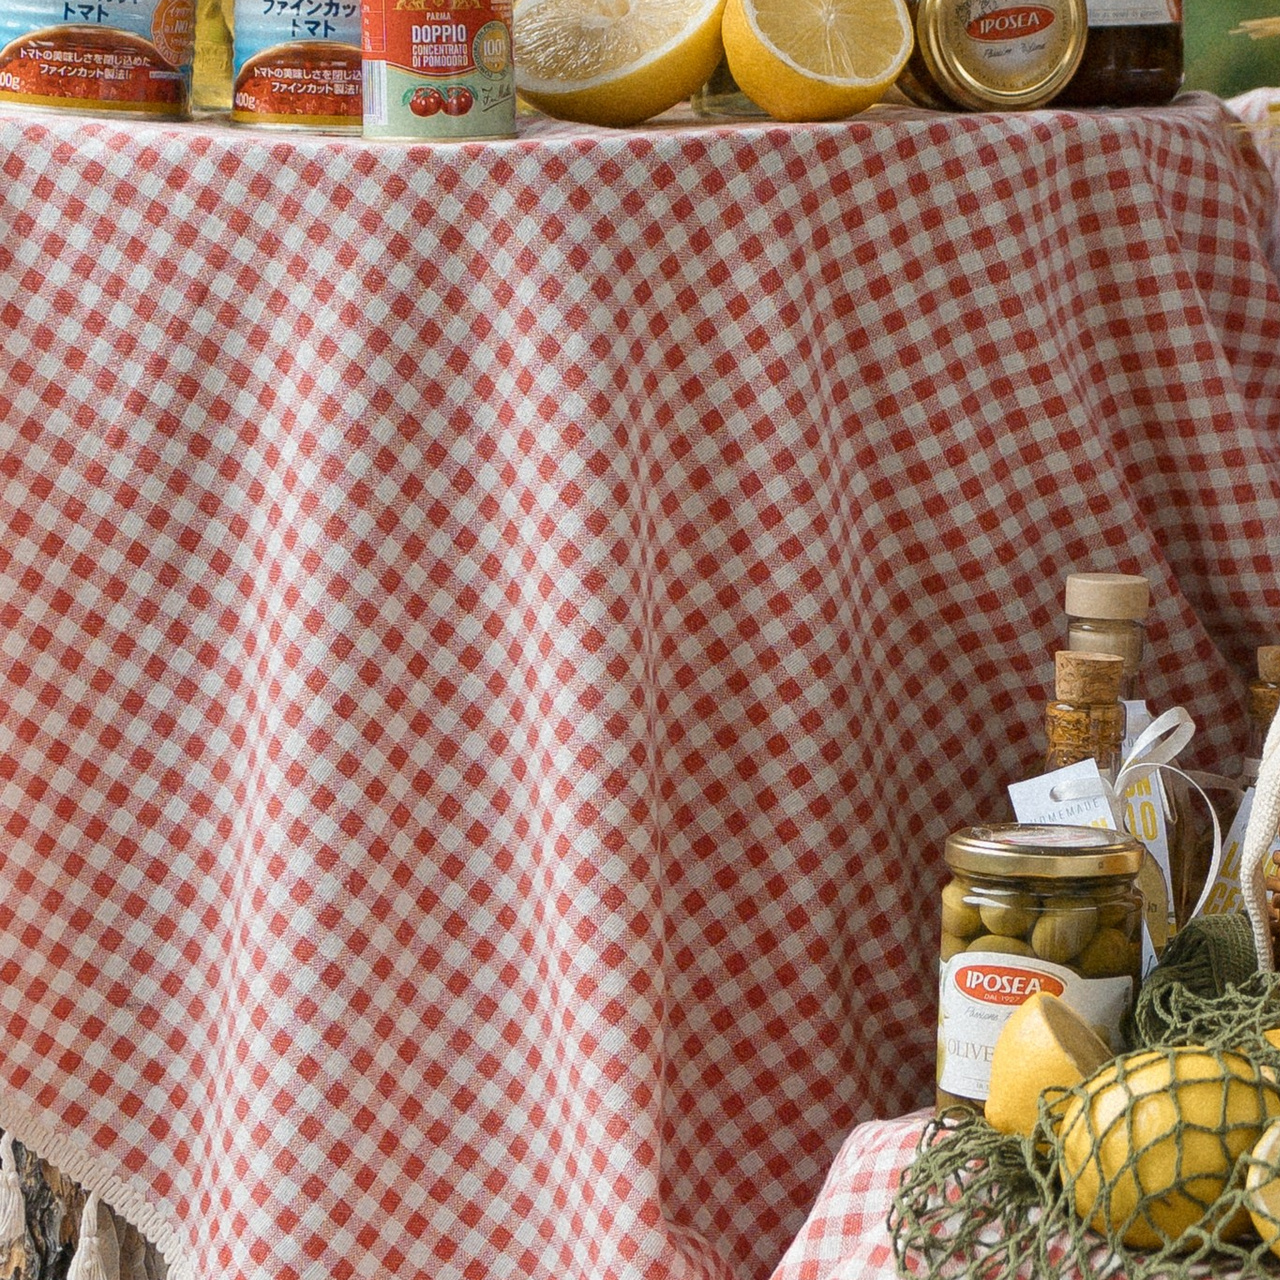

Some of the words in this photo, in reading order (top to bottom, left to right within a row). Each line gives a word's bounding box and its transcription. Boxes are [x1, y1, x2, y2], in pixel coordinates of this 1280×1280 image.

[62, 4, 110, 24] トマト
[426, 11, 452, 21] PARMA
[980, 10, 1041, 35] IPOSEA
[291, 19, 337, 40] トマト
[411, 24, 467, 43] DOPPIO
[20, 48, 151, 67] トマトの美味しさを閉じ込めた
[412, 43, 468, 55] CONCENTRATO
[412, 55, 422, 67] DI
[423, 55, 469, 67] POMODORO
[0, 71, 20, 89] 00g
[254, 66, 362, 81] トマトの美味しさを閉じ込
[235, 92, 256, 110] 400g
[965, 970, 1042, 996] IPOSEA
[983, 993, 998, 1001] DAL
[947, 1038, 995, 1063] OLIVE
